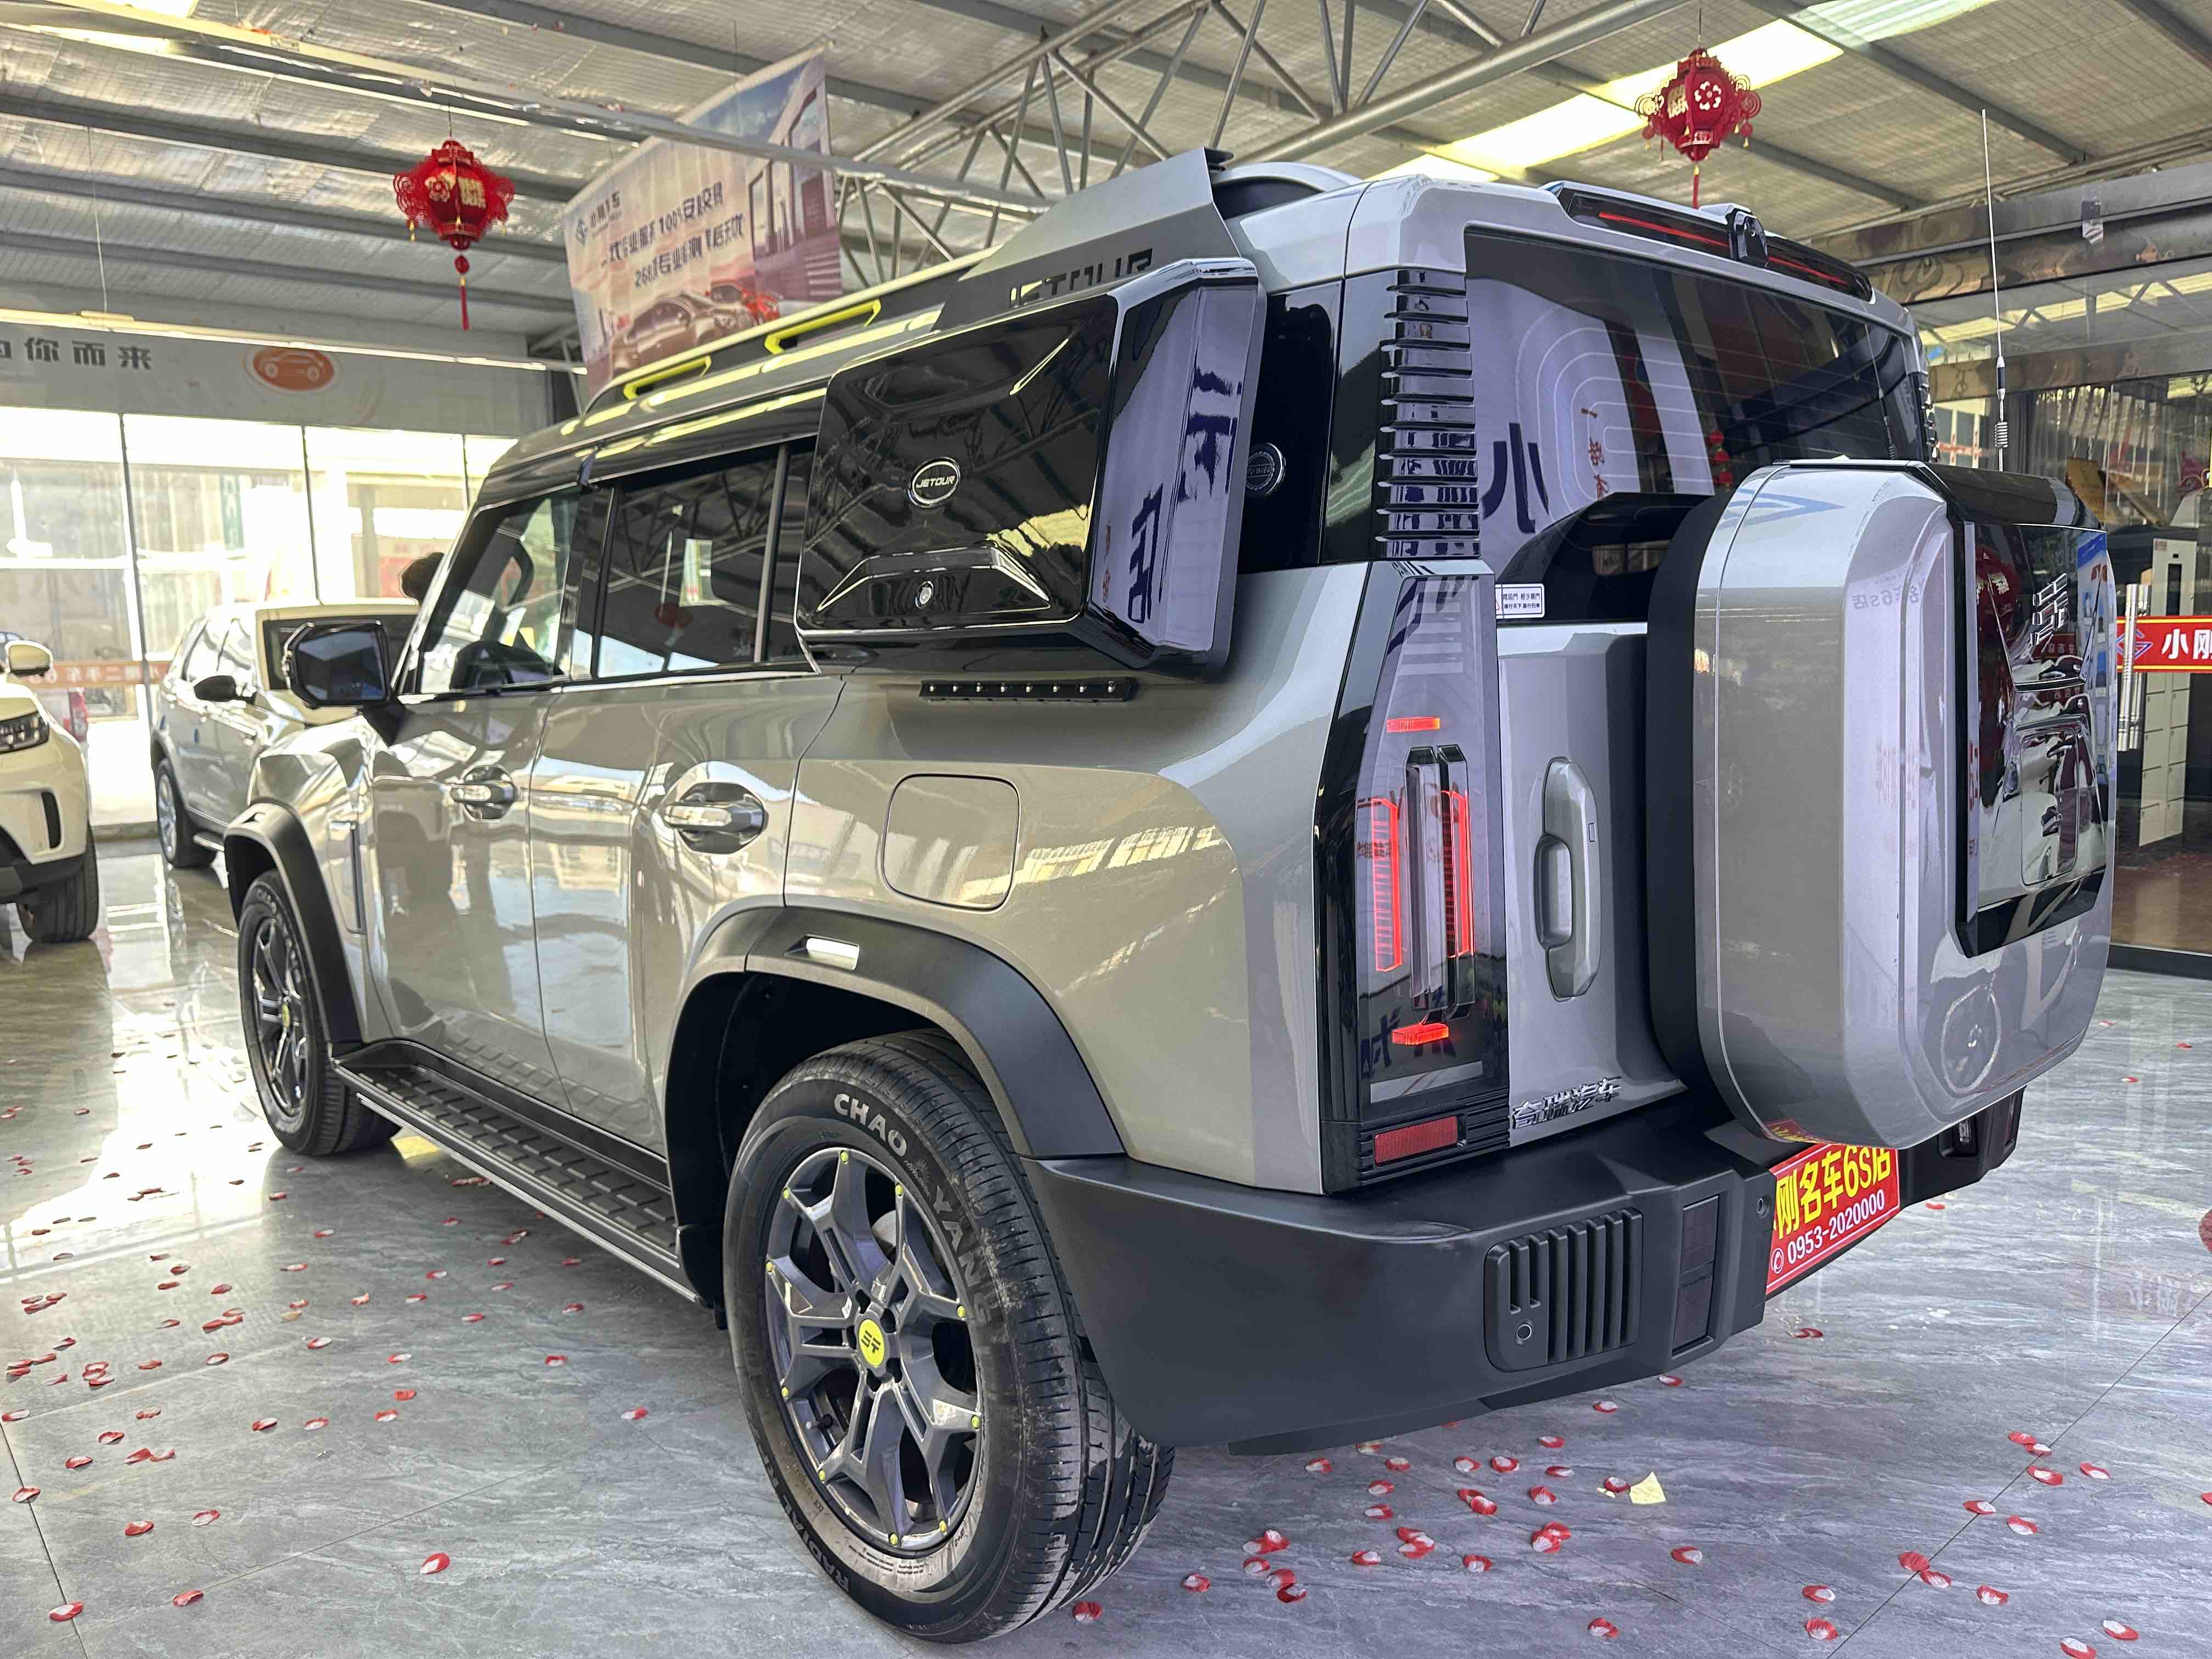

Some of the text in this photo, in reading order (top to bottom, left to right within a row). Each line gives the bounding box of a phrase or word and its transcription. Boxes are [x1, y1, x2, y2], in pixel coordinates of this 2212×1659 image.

[916, 475, 955, 488] JETOUR
[2162, 628, 2212, 660] 小刚
[834, 1093, 907, 1156] CHAO
[1787, 1188, 1886, 1265] 0953-2020000
